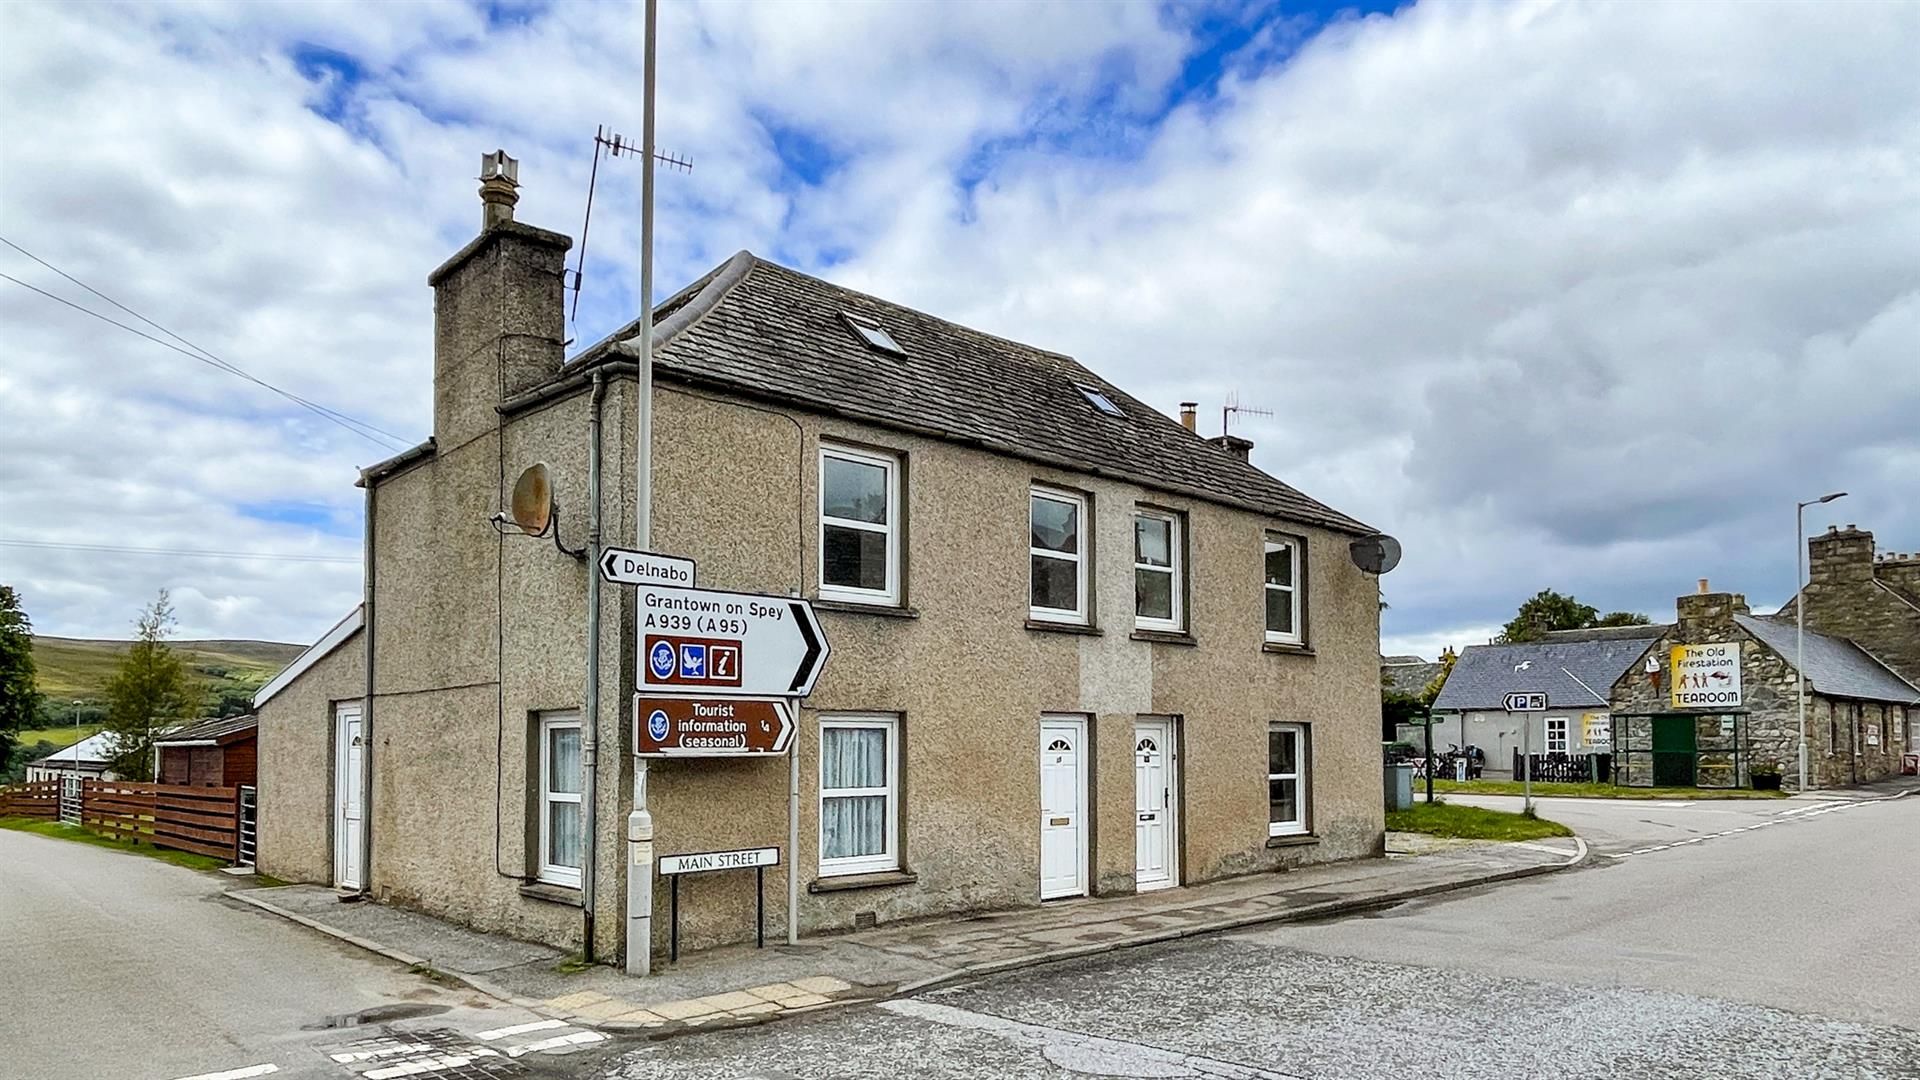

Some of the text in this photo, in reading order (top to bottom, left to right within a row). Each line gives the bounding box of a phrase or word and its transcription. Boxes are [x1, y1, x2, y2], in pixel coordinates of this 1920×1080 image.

[624, 559, 688, 581] Delnabo
[645, 593, 783, 620] Grantown on Spey
[1685, 648, 1725, 657] The Old
[1677, 659, 1733, 668] Firestation
[1517, 697, 1526, 707] P
[1675, 692, 1738, 704] TEAROOM
[692, 703, 734, 717] Tourist
[678, 719, 747, 732] information
[679, 733, 746, 749] (seasonal)
[678, 852, 761, 871] MAIN STREET
